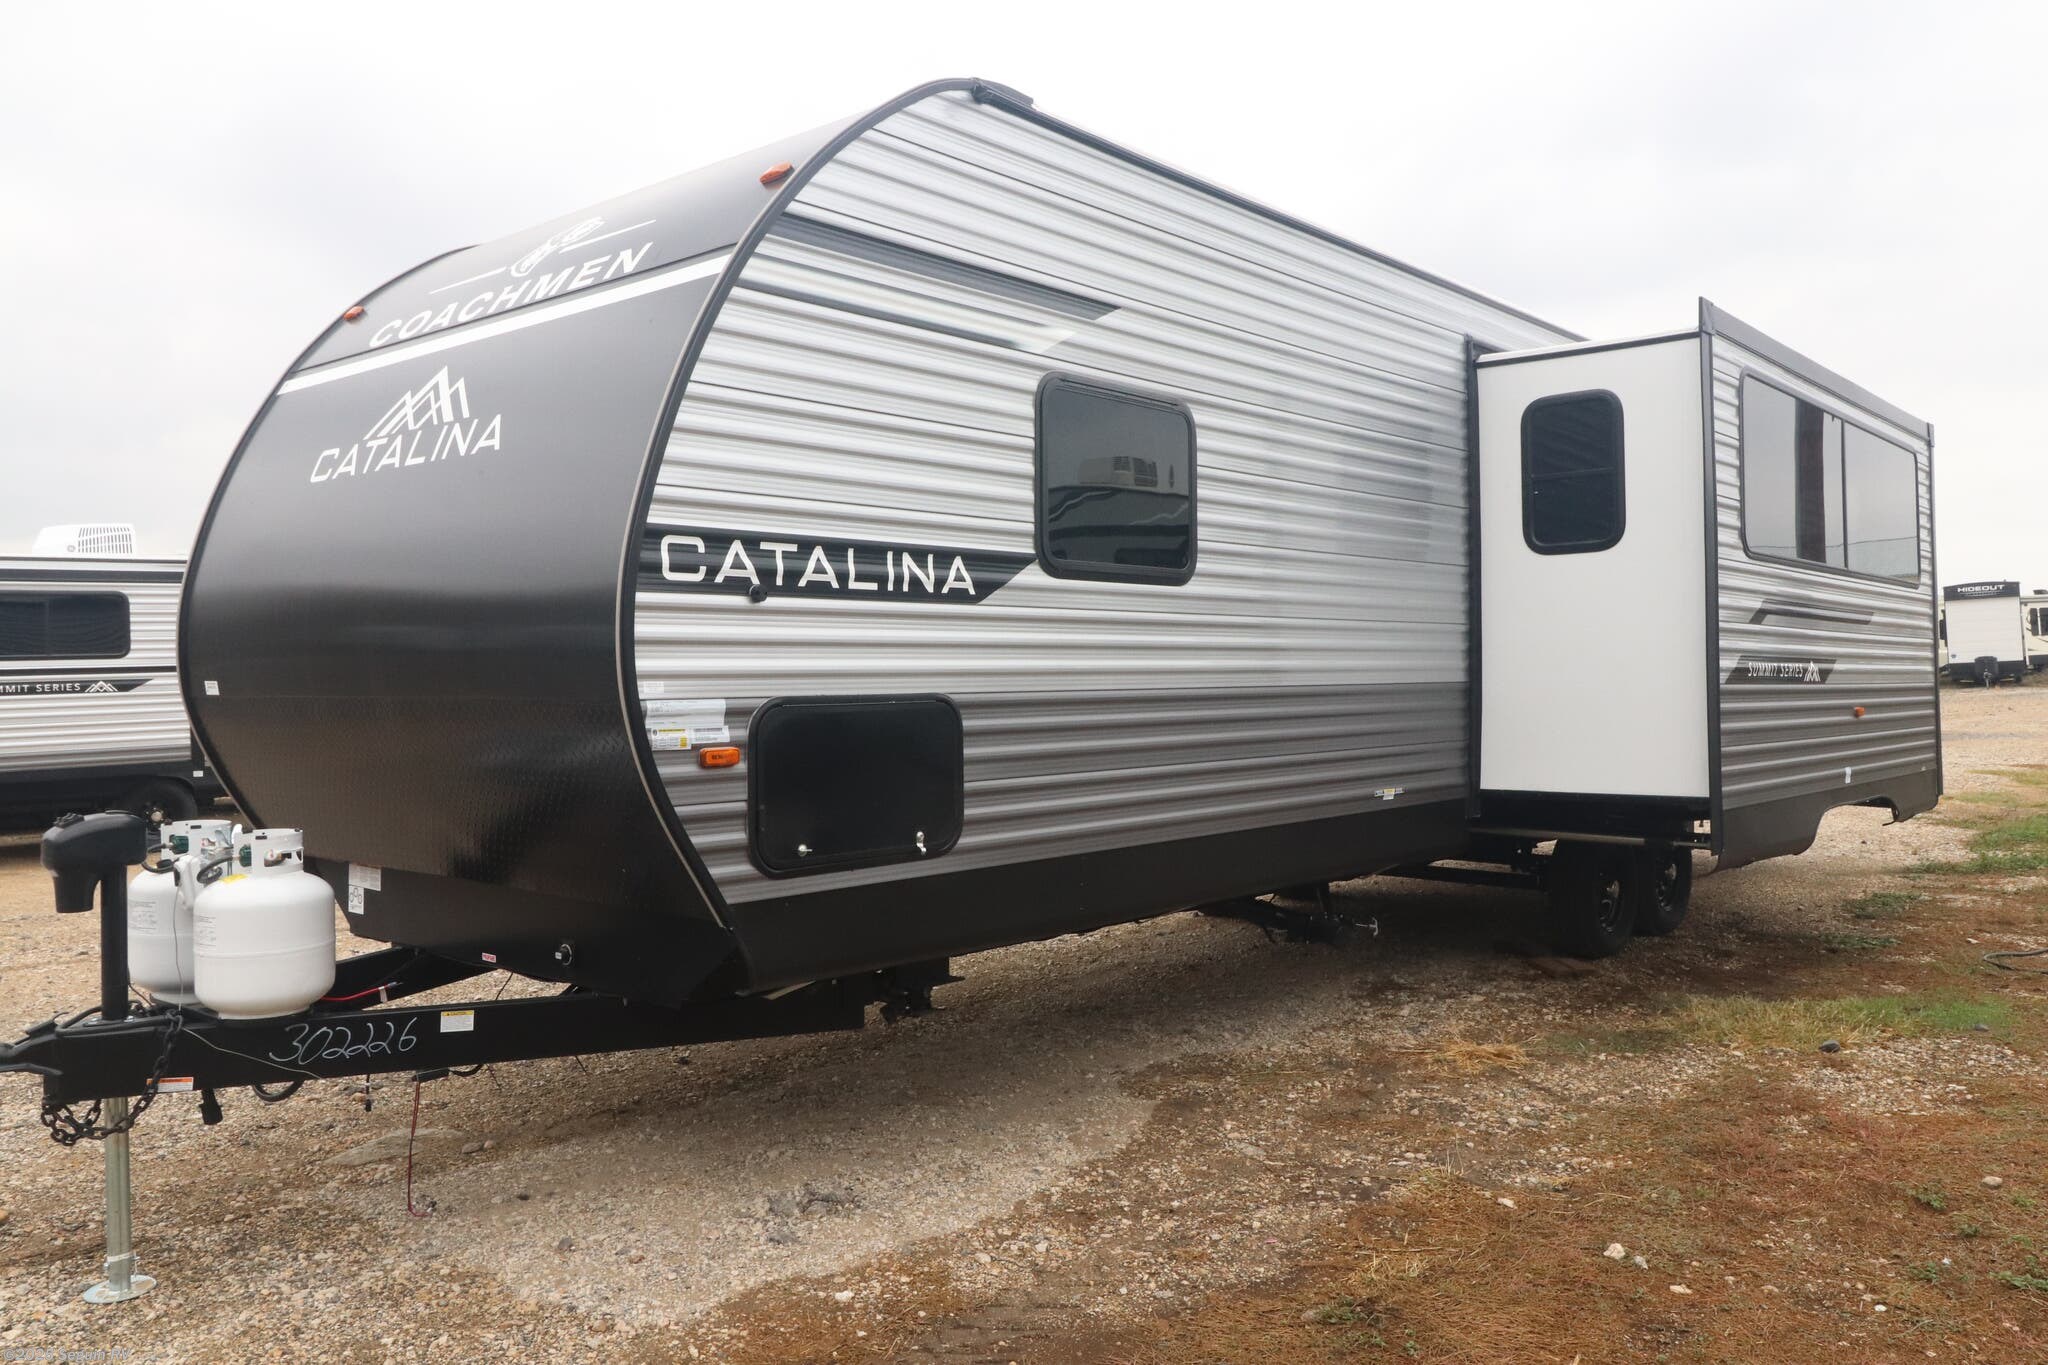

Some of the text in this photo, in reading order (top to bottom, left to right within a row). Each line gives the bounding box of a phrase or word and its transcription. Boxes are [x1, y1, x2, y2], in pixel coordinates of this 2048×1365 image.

[368, 242, 653, 348] COACHMEN
[310, 414, 502, 483] CATALINA
[660, 535, 976, 595] CATALINA
[1957, 584, 2005, 593] HIDEOUT
[36, 683, 81, 692] SERIES
[1748, 662, 1804, 677] SUMMIT SERIES
[269, 1017, 418, 1065] 302226
